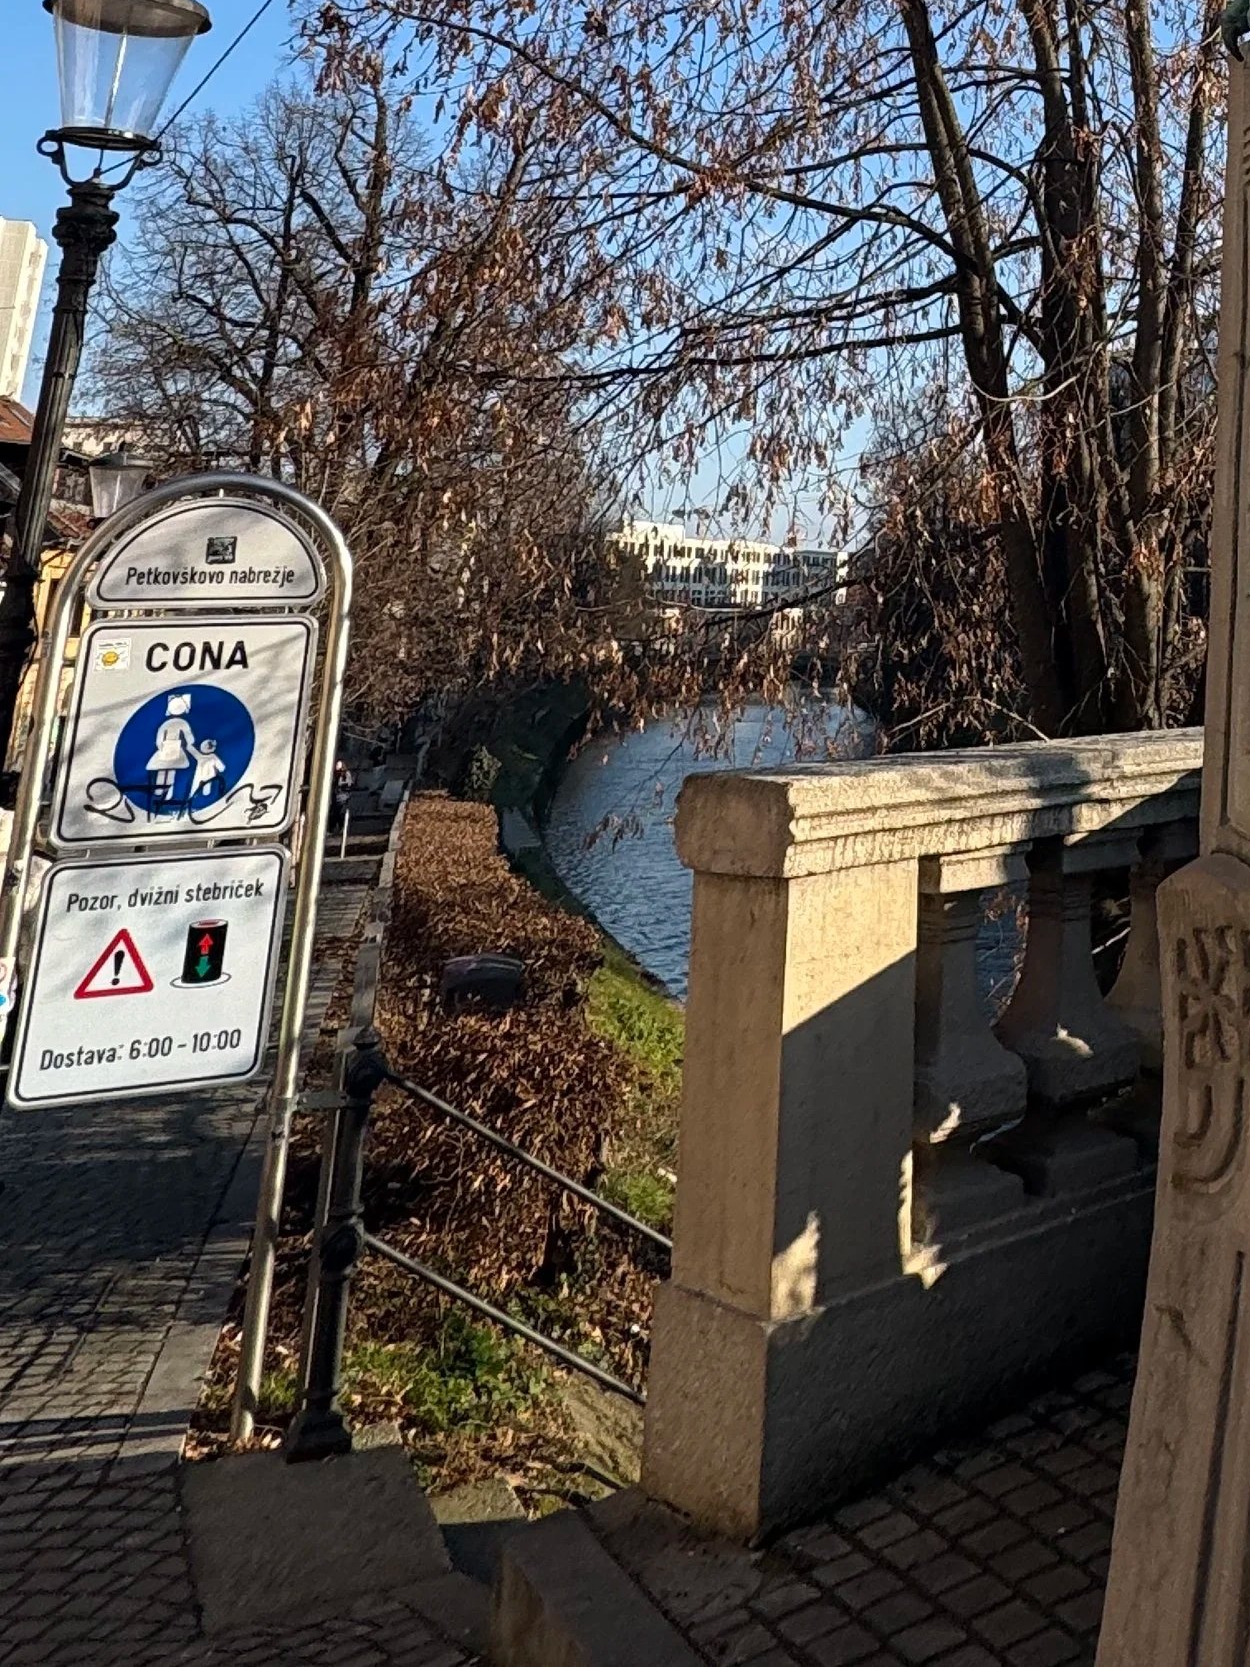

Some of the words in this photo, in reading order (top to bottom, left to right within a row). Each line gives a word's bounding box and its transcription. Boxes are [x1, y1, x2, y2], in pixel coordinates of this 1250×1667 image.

[125, 566, 225, 585] Petkovškovo
[228, 565, 295, 588] nabrežje
[145, 639, 250, 673] CONA
[66, 893, 122, 913] Pozor,
[127, 884, 180, 908] dvižni
[184, 877, 265, 903] stebriček
[39, 1044, 125, 1071] Dostava:
[129, 1035, 173, 1060] 6:00
[192, 1028, 242, 1053] 10:00
